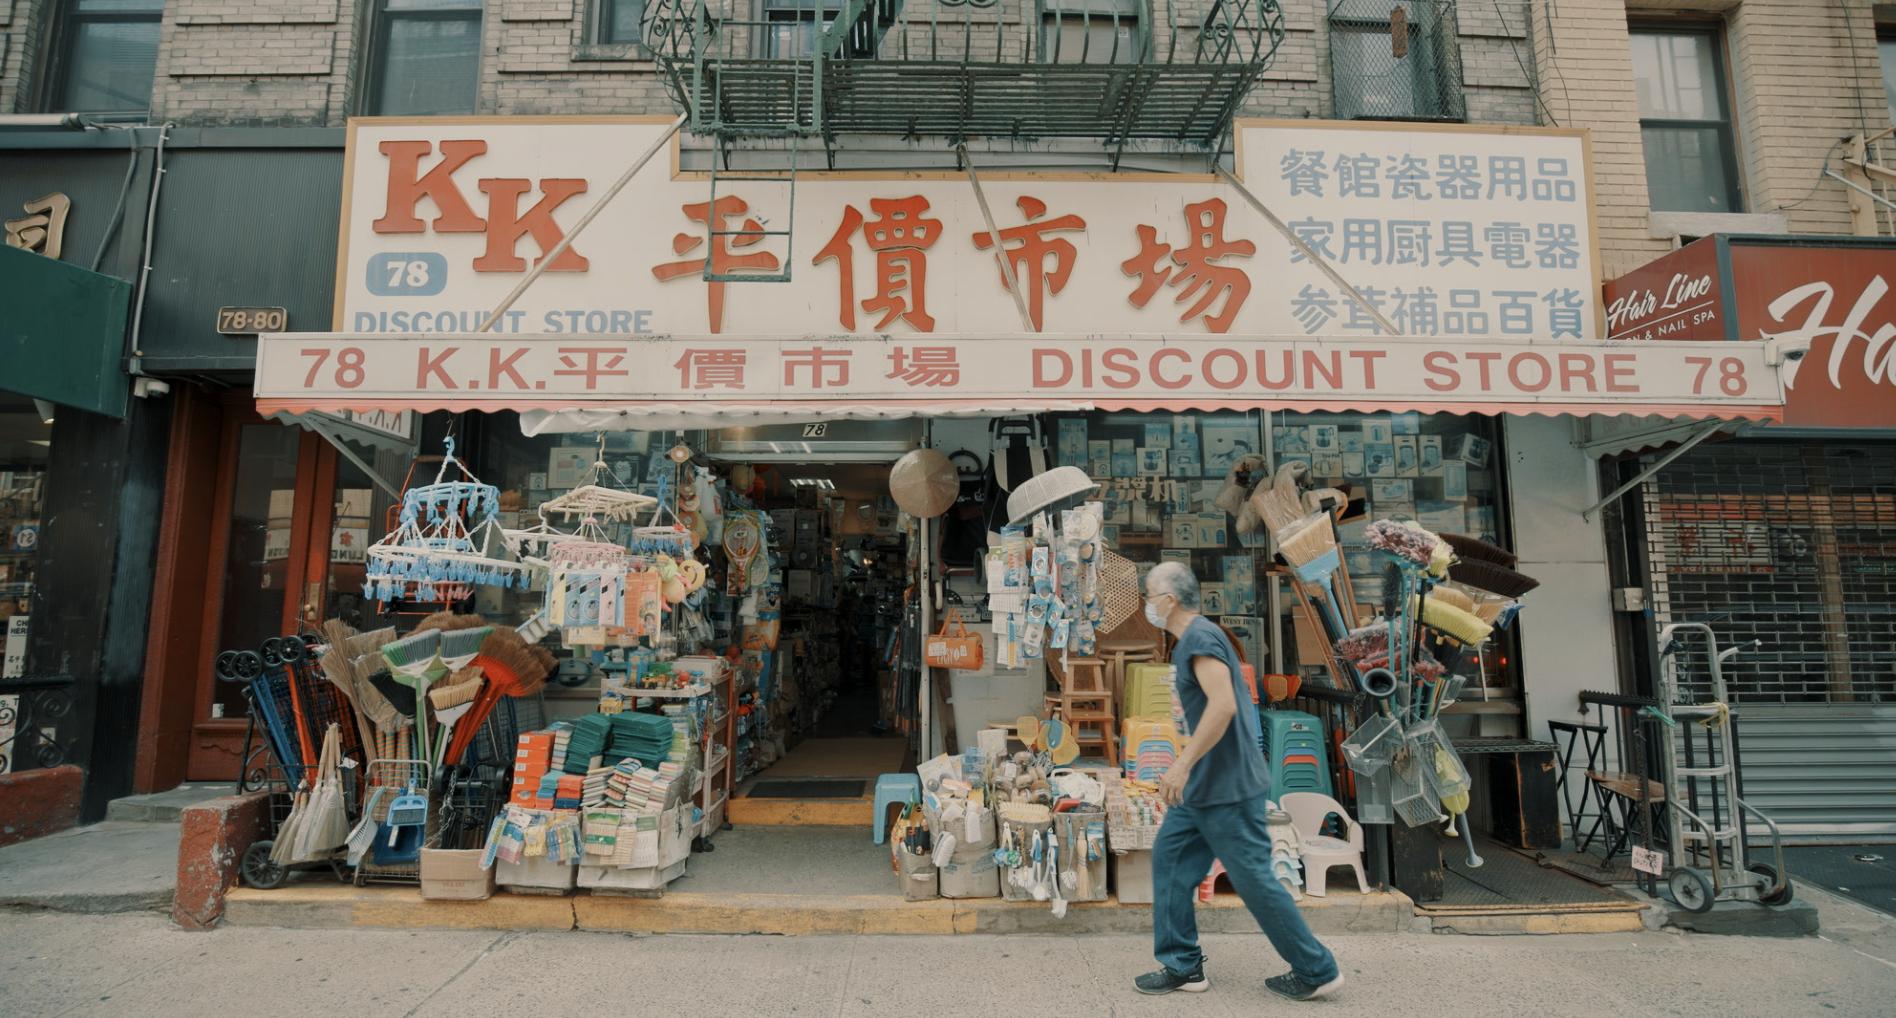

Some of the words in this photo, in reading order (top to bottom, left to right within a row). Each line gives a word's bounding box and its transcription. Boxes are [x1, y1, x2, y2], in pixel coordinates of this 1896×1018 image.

[1279, 148, 1577, 203] 餐館瓷器用品
[386, 261, 430, 288] 78
[651, 193, 1257, 334] 平價市場
[1607, 289, 1658, 330] Hair
[1660, 273, 1712, 309] Line
[222, 310, 282, 330] 78-80
[354, 310, 526, 333] DISCOUNT
[543, 310, 653, 333] STORE
[1658, 319, 1687, 336] NAIL
[1693, 309, 1716, 325] SPA
[300, 347, 366, 389] 78
[1031, 348, 1387, 390] DISCOUNT
[1423, 351, 1640, 393] STORE
[1684, 356, 1748, 397] 78
[805, 424, 825, 436] 78
